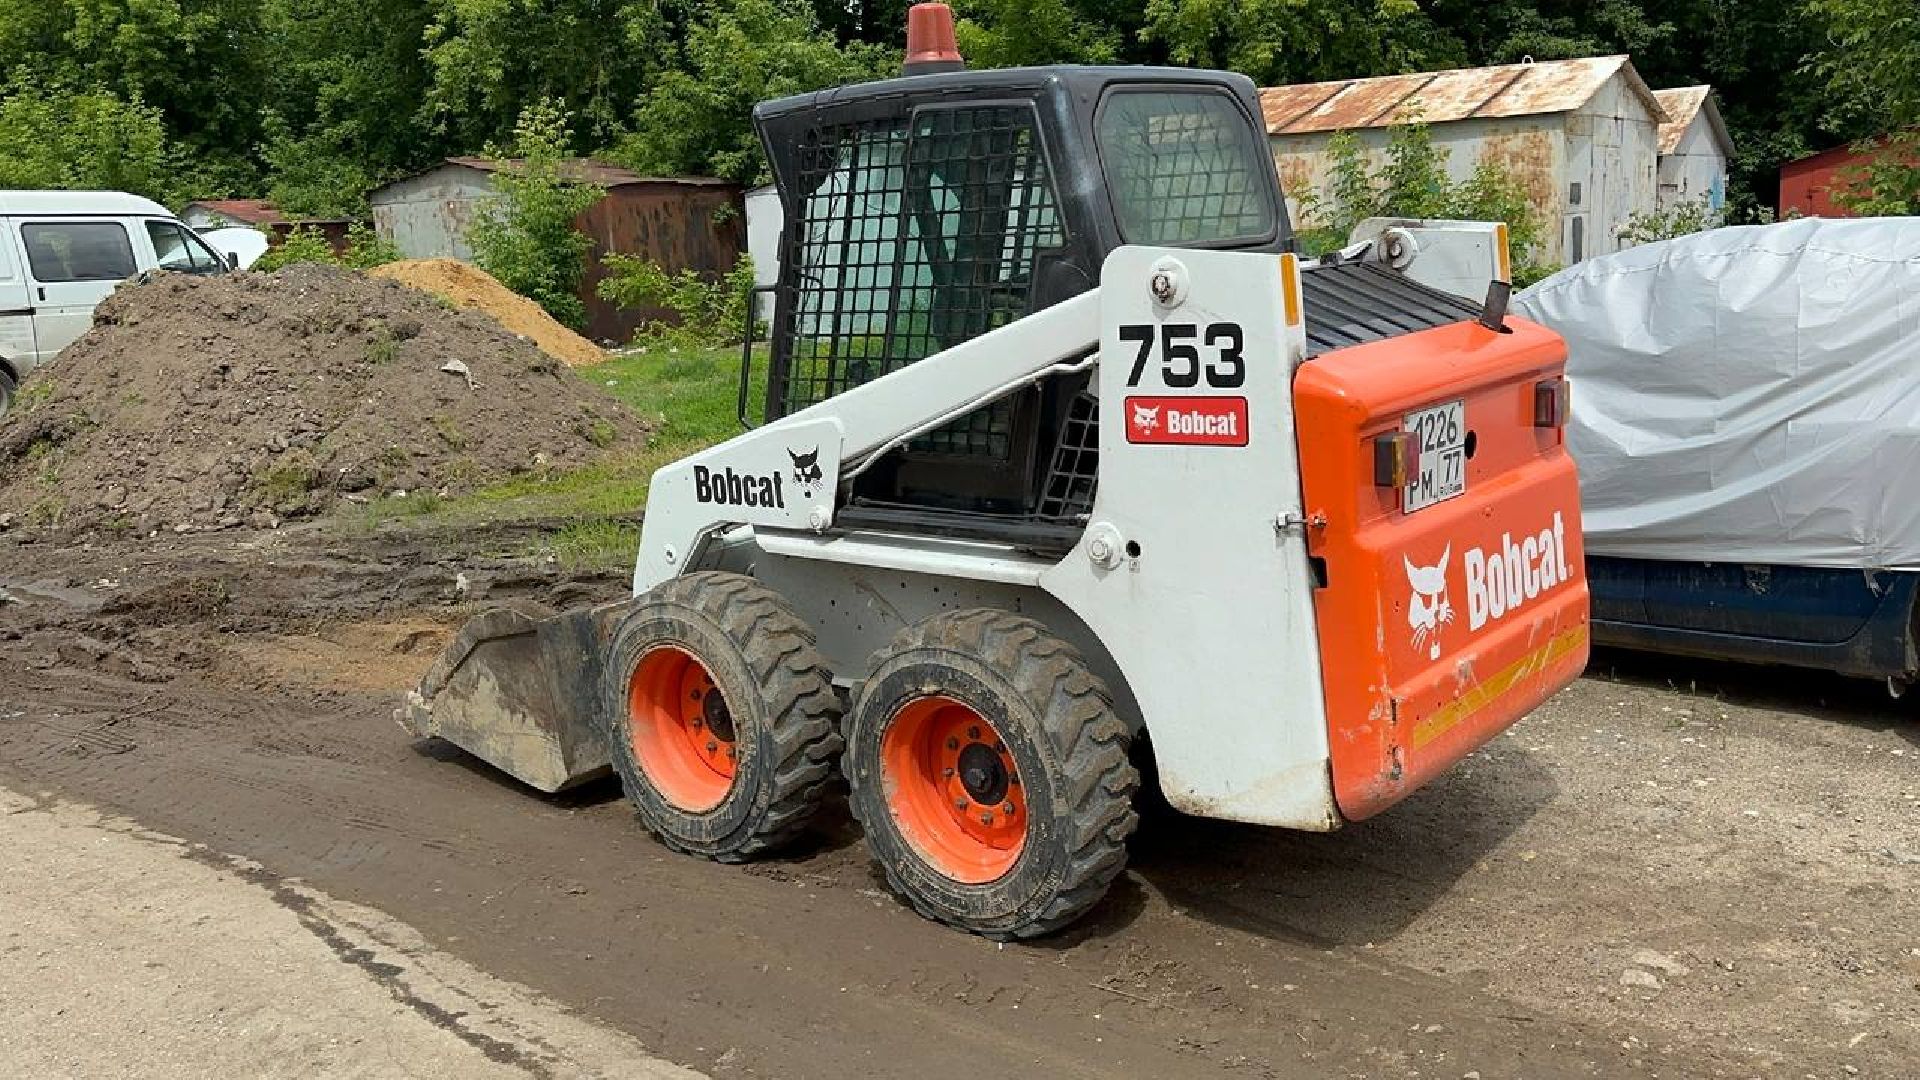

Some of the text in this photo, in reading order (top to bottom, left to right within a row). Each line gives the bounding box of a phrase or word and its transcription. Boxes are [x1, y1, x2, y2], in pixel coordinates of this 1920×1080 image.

[1119, 323, 1246, 389] 753
[1166, 410, 1238, 436] Bobcat
[1413, 405, 1457, 455] 1226
[693, 464, 785, 509] Bobcat
[1442, 450, 1462, 484] 77
[1464, 510, 1567, 632] Bobcat
